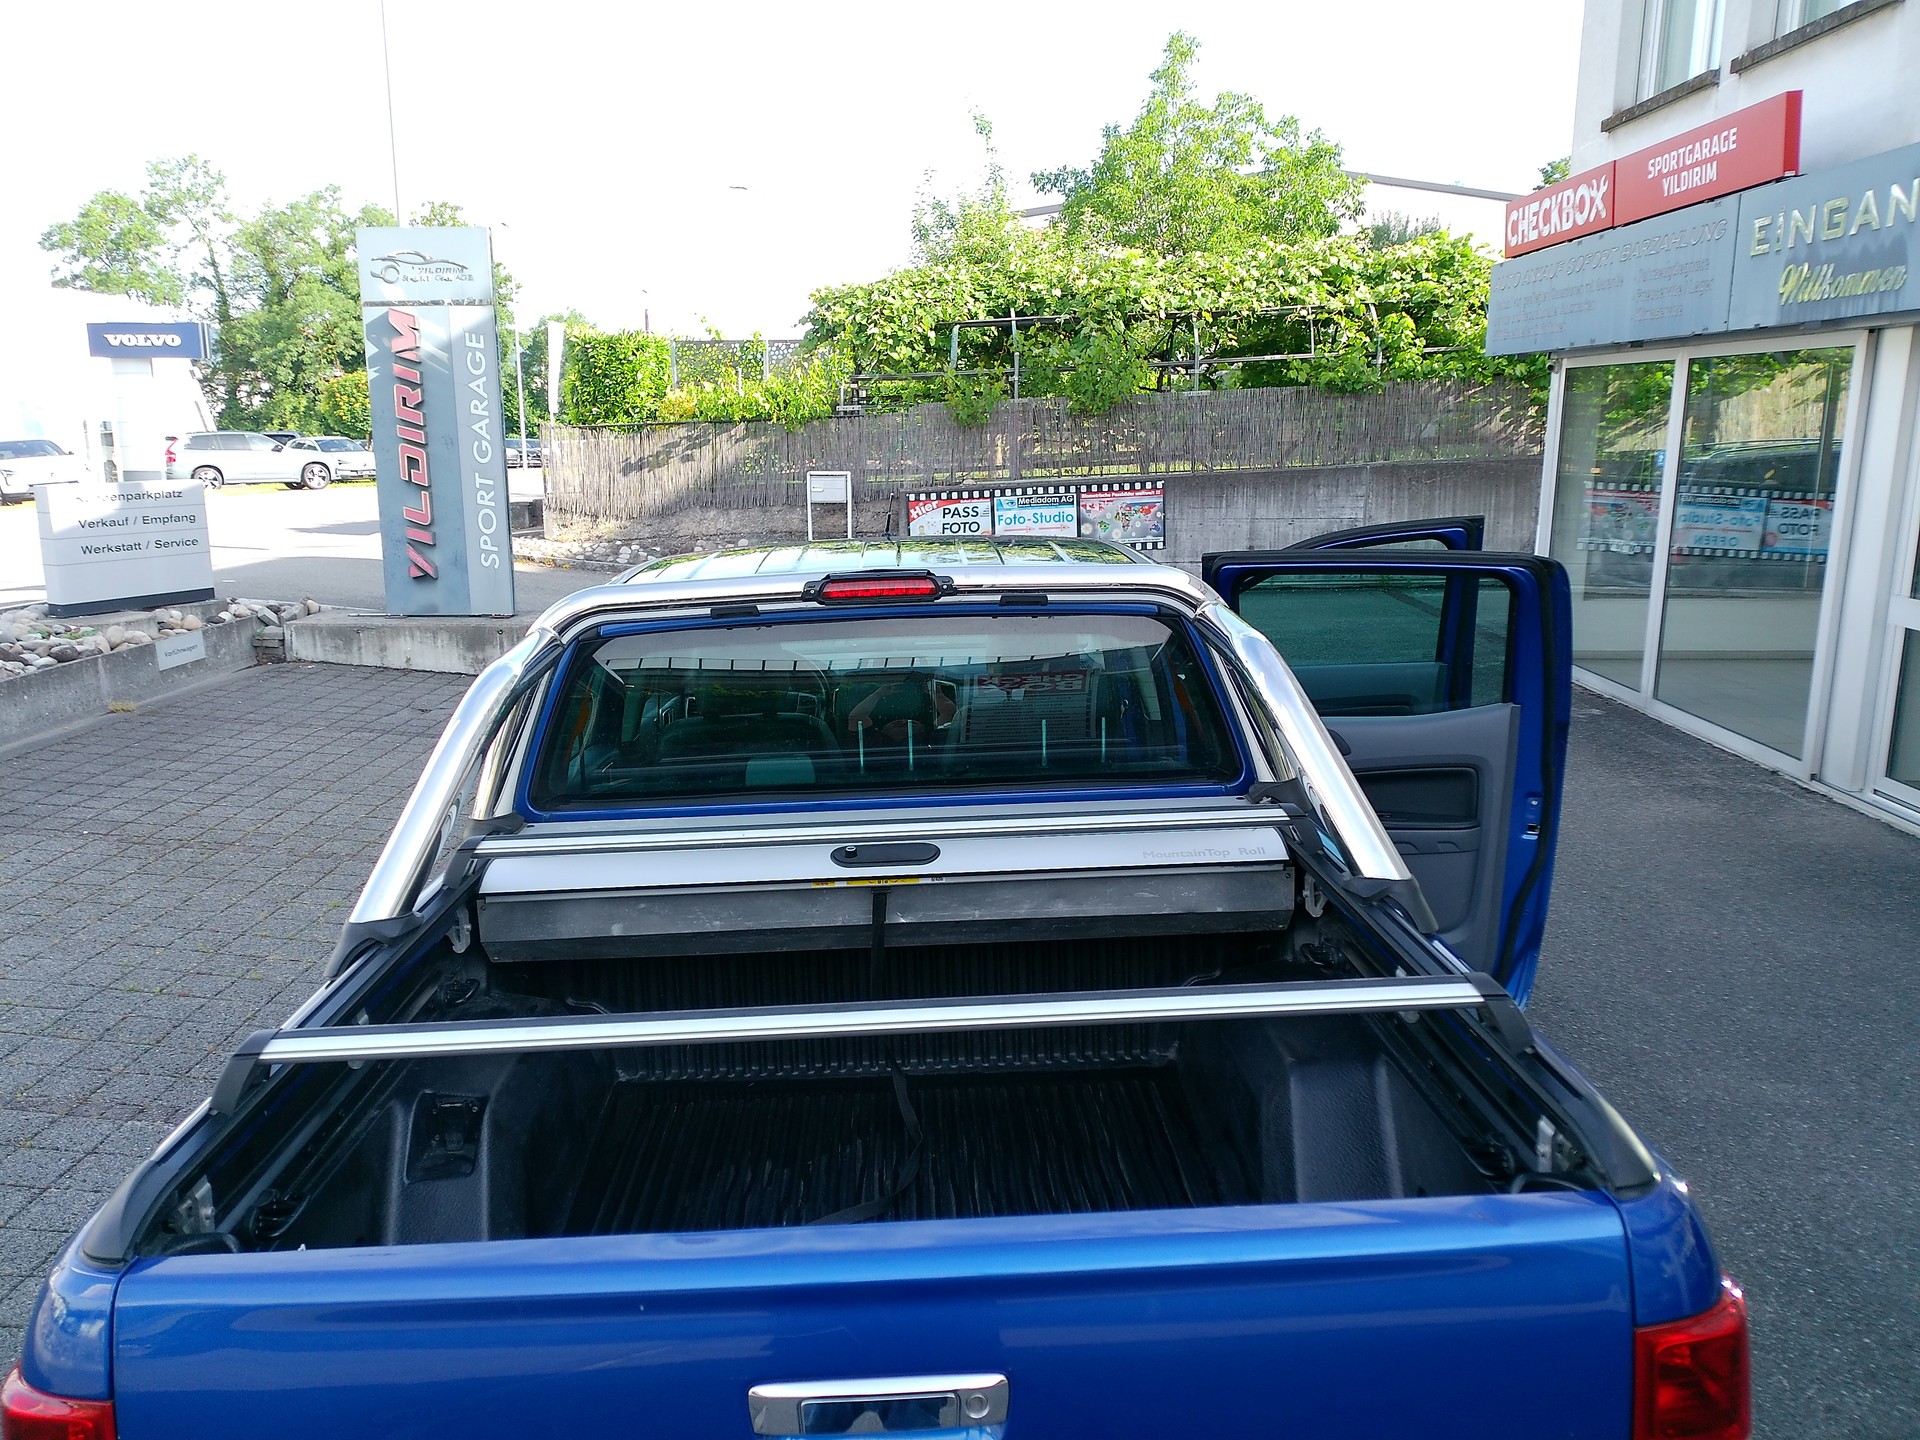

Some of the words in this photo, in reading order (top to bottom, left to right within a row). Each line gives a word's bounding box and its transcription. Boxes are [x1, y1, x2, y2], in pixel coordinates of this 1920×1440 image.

[1647, 127, 1738, 179] SPORTGARAGE
[1661, 160, 1718, 197] YILDIRIM
[1507, 174, 1609, 247] CHECKBOX
[1566, 246, 1620, 276] SOFORT
[1619, 218, 1728, 263] BARZAHLUNG
[1778, 261, 1908, 305] Willkommen
[103, 333, 182, 347] VOLVO
[465, 331, 493, 465] GARAGE
[388, 307, 439, 580] YILDIRIM
[909, 500, 939, 519] Hier
[1018, 495, 1059, 505] Mediadom
[1060, 495, 1074, 503] AG
[78, 516, 129, 529] Verkauf
[142, 513, 197, 526] Empfang
[474, 472, 501, 570] SPORT
[942, 506, 979, 519] PASS
[997, 511, 1074, 526] Foto-Studio
[942, 521, 980, 535] FOTO
[81, 541, 142, 555] Werkstatt
[154, 537, 199, 550] Service
[1142, 848, 1231, 859] MountainTop
[1237, 846, 1266, 856] Roll
